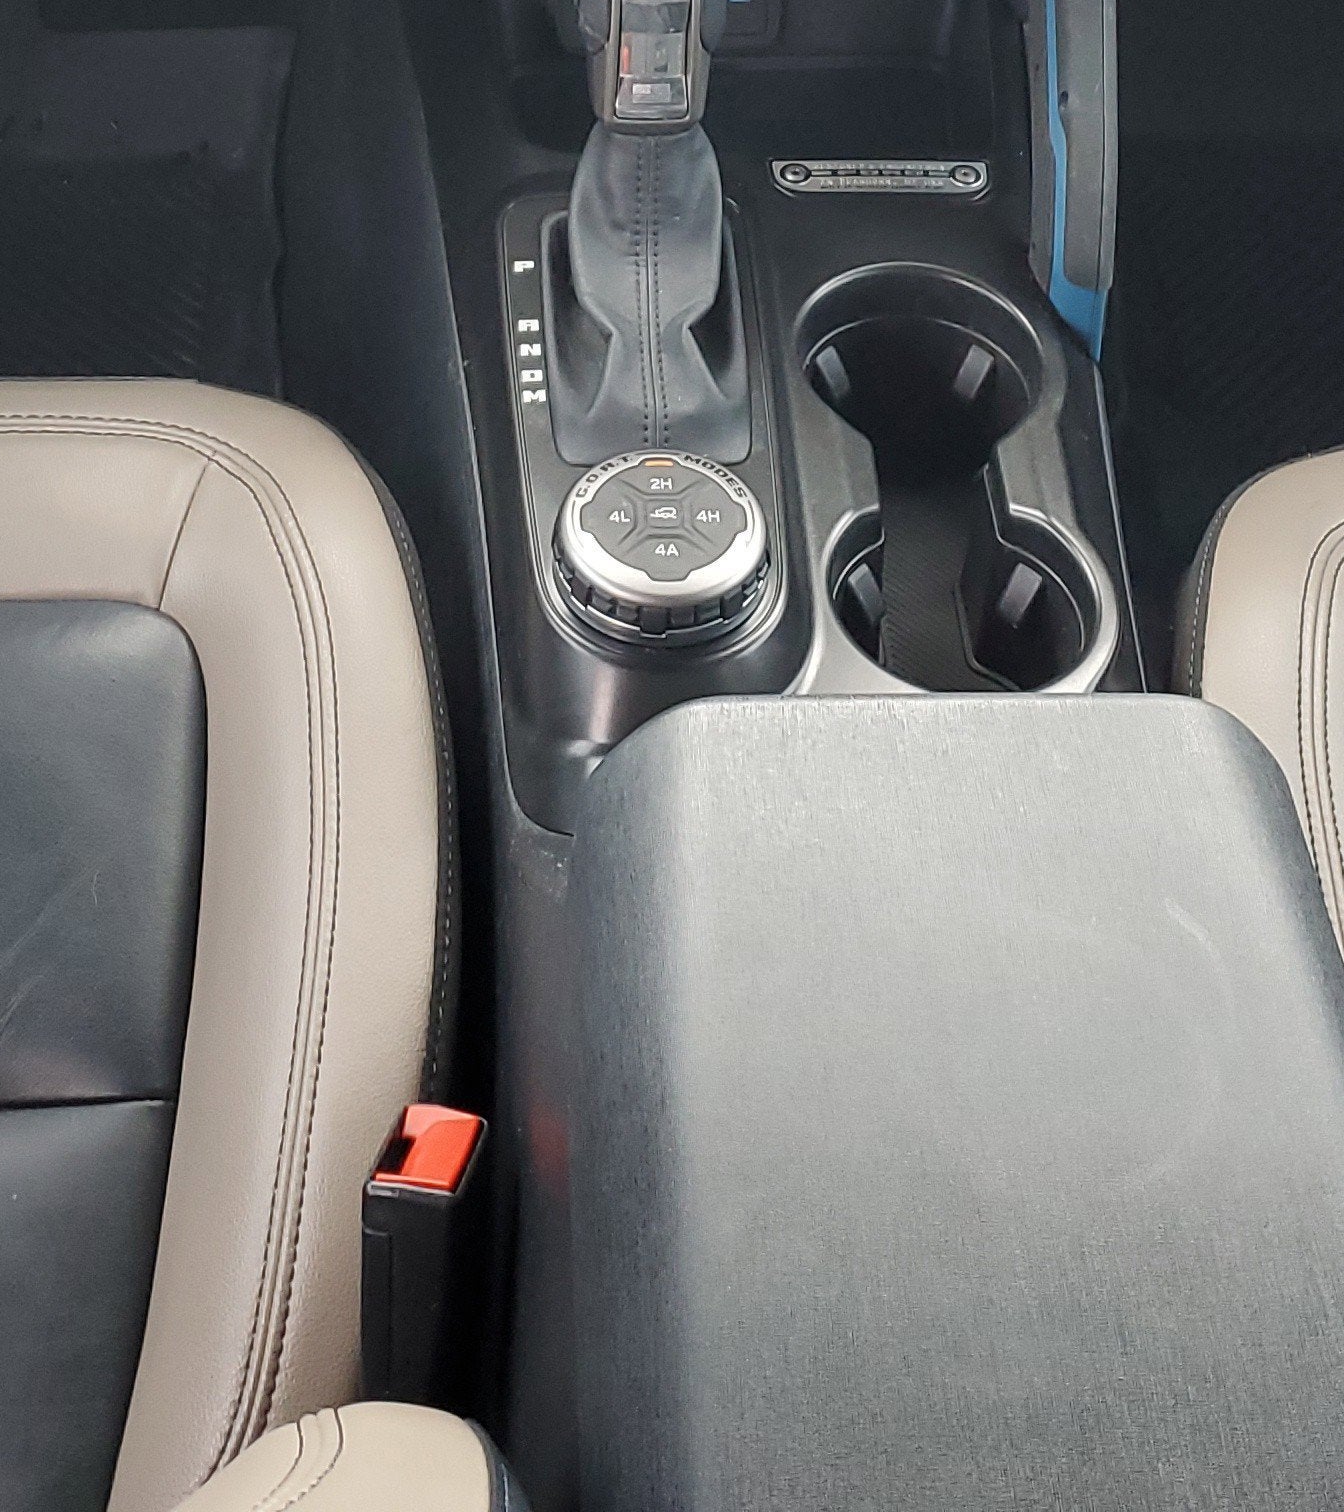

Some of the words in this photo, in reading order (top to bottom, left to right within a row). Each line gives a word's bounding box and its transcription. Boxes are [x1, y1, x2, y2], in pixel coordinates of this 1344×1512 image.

[513, 260, 535, 273] P
[520, 343, 542, 356] N
[521, 369, 543, 382] D
[522, 389, 546, 403] M
[684, 454, 748, 499] MODES
[649, 478, 672, 490] 2H
[609, 510, 631, 523] 4L
[696, 510, 721, 523] 4H
[655, 544, 679, 557] 4A
